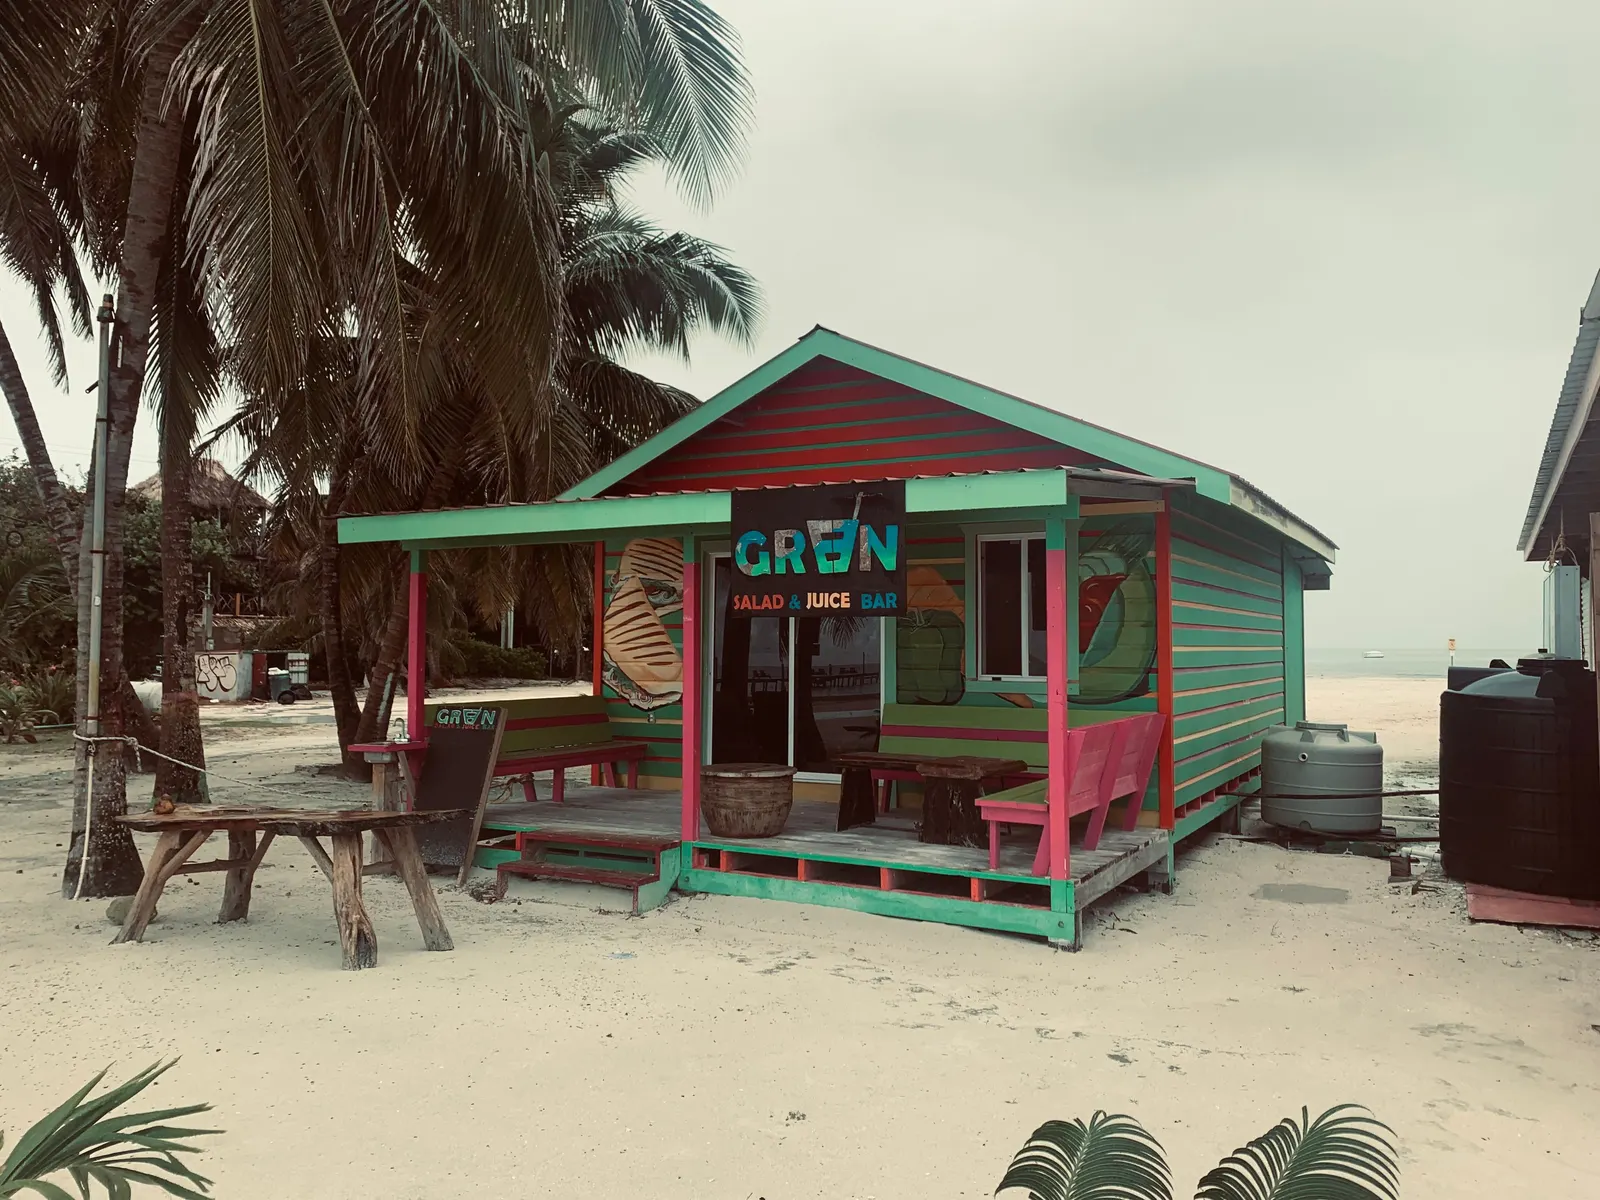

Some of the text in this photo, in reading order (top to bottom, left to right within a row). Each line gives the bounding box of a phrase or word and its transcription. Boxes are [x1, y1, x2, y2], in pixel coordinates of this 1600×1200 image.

[733, 592, 898, 610] SALAD & JUICE BAR
